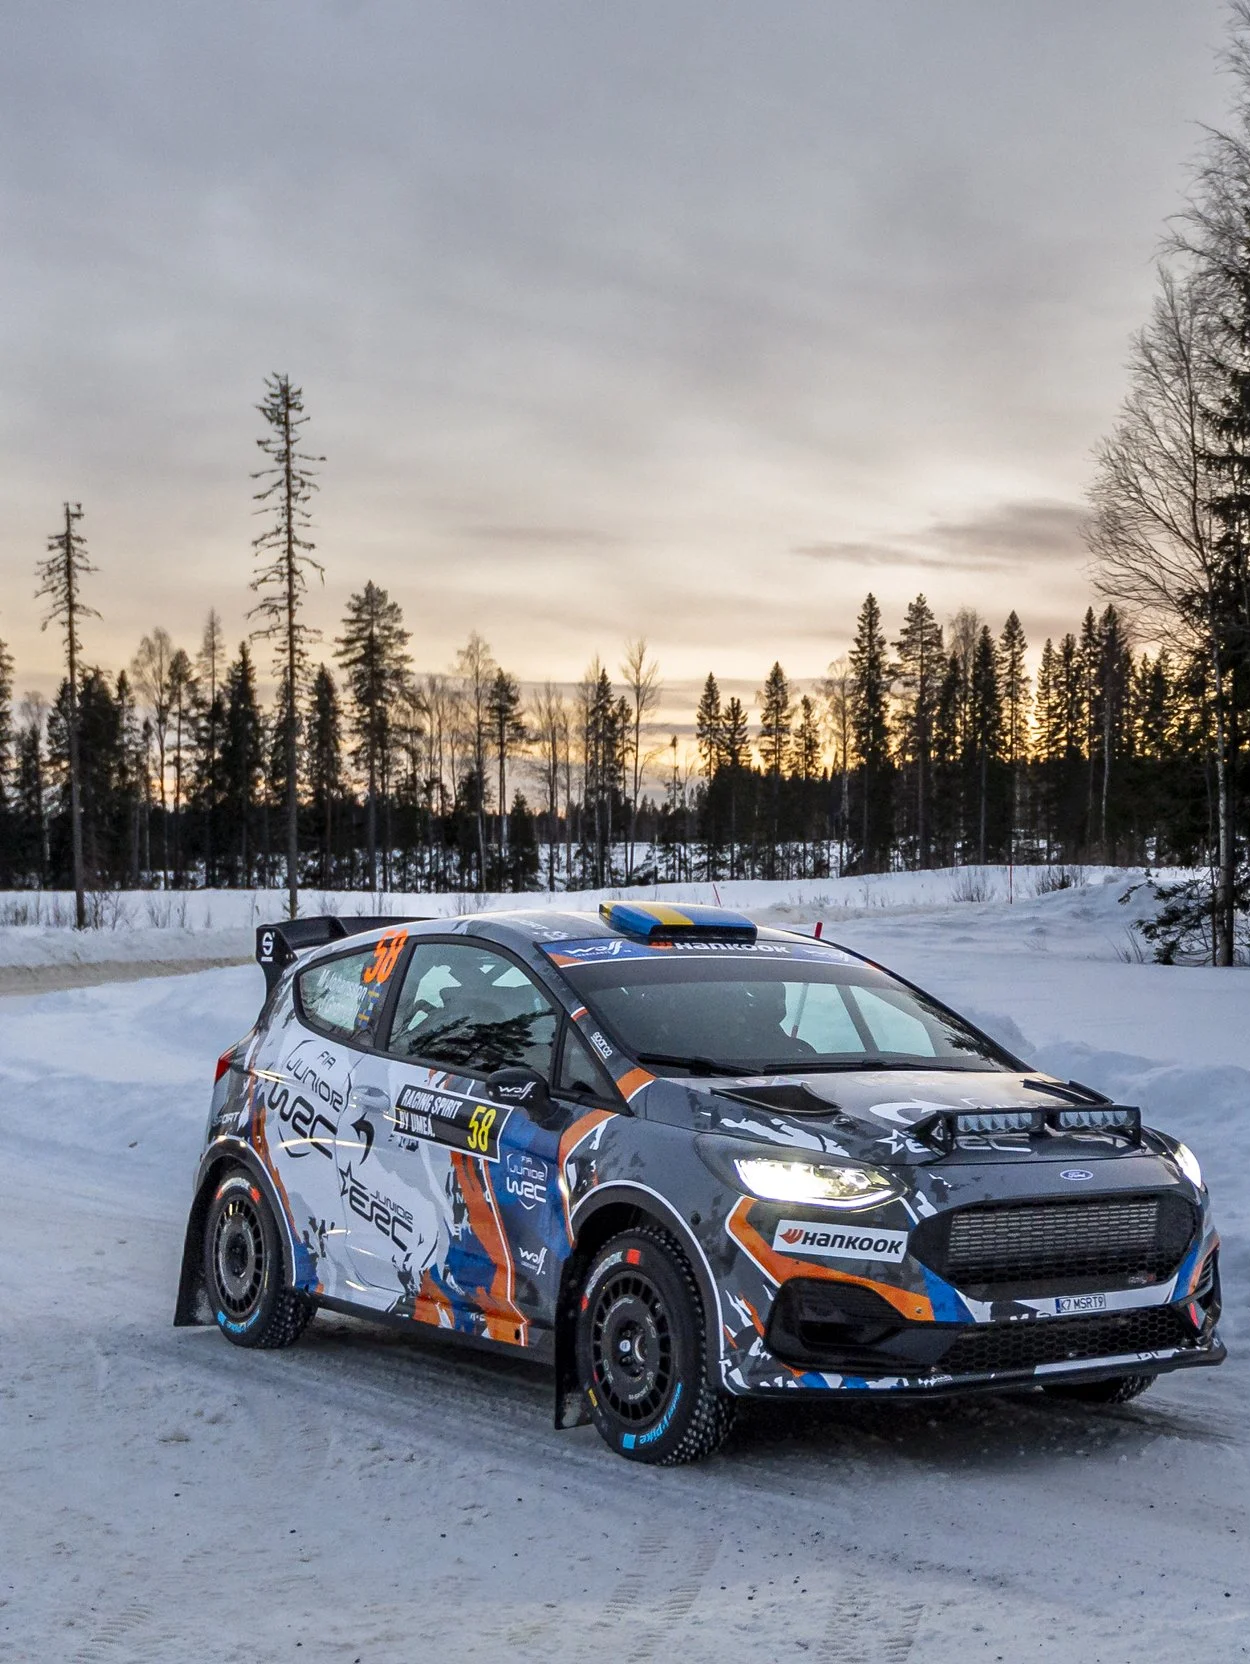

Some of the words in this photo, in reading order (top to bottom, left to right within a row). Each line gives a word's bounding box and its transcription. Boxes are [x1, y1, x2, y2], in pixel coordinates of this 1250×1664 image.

[363, 928, 408, 984] 58
[592, 1031, 613, 1057] sparco
[317, 1050, 337, 1071] FIA
[286, 1057, 344, 1113] JUNIOR
[498, 1081, 536, 1100] wolf
[400, 1088, 433, 1112] RACING
[432, 1094, 464, 1120] SPIRIT
[265, 1076, 338, 1160] WRC
[398, 1108, 410, 1129] BY
[466, 1105, 497, 1152] 58
[510, 1164, 546, 1180] JUNIOR
[521, 1155, 533, 1165] FIA
[1066, 1170, 1088, 1180] Ford
[506, 1176, 547, 1203] WRC
[348, 1176, 414, 1252] ERC
[370, 1190, 414, 1226] JUNIOR
[518, 1246, 548, 1275] wolf
[1074, 1296, 1104, 1310] MSRT9
